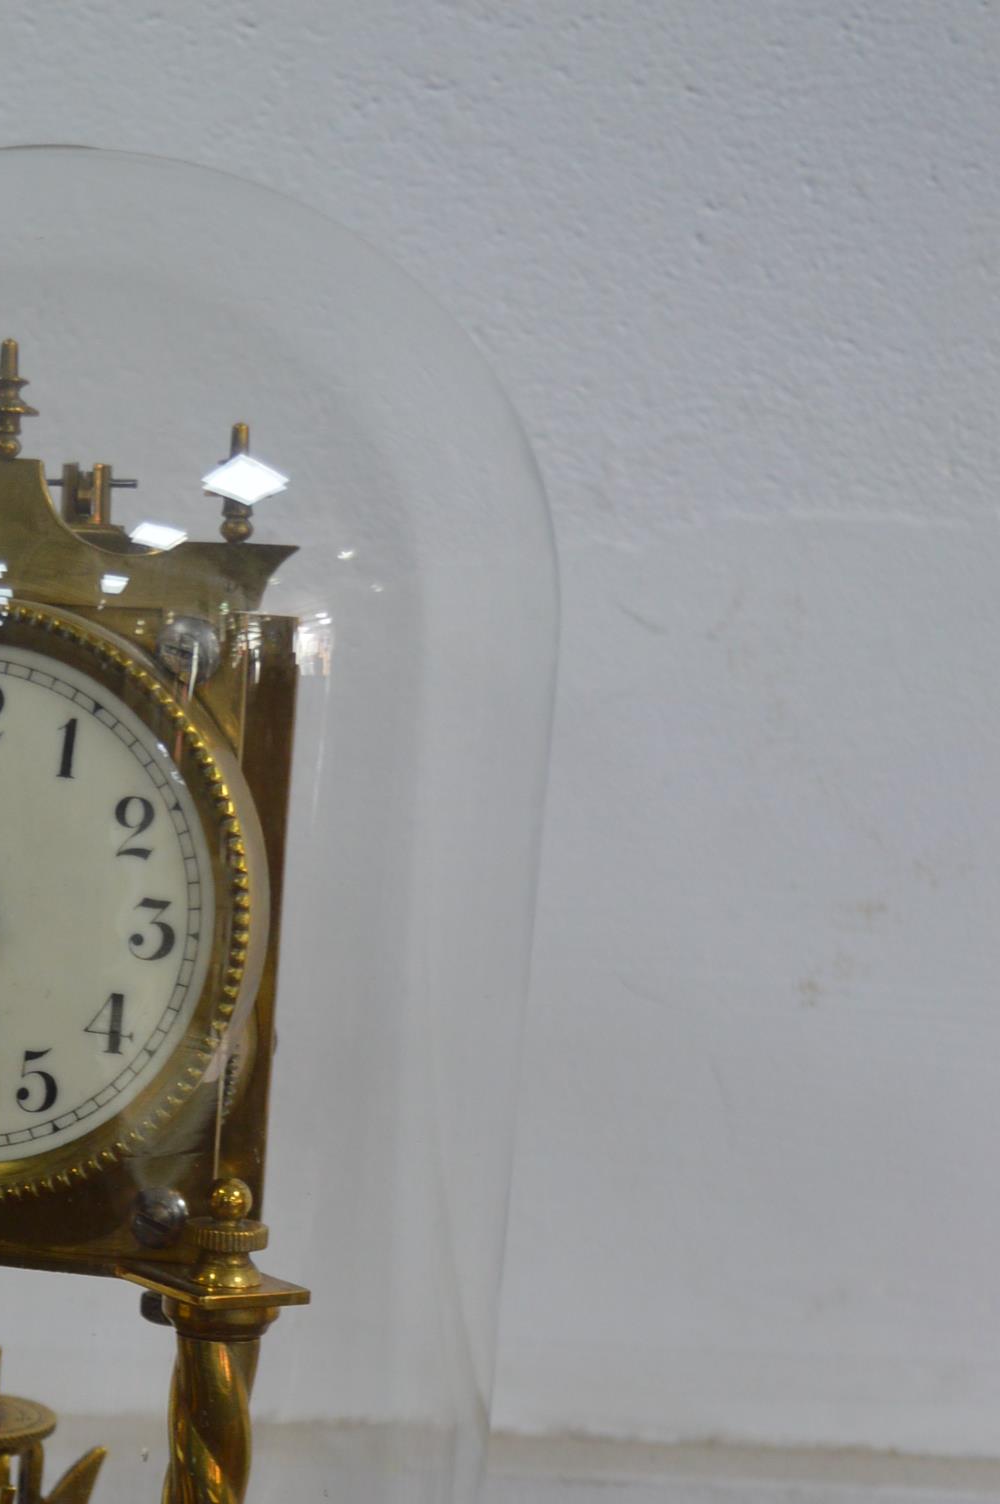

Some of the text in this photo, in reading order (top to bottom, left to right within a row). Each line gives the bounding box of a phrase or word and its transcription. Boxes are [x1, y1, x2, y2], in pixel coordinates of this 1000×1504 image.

[55, 717, 80, 780] 1
[113, 796, 157, 862] 2
[127, 897, 177, 962] 3
[83, 992, 135, 1056] 4
[15, 1047, 59, 1114] 5
